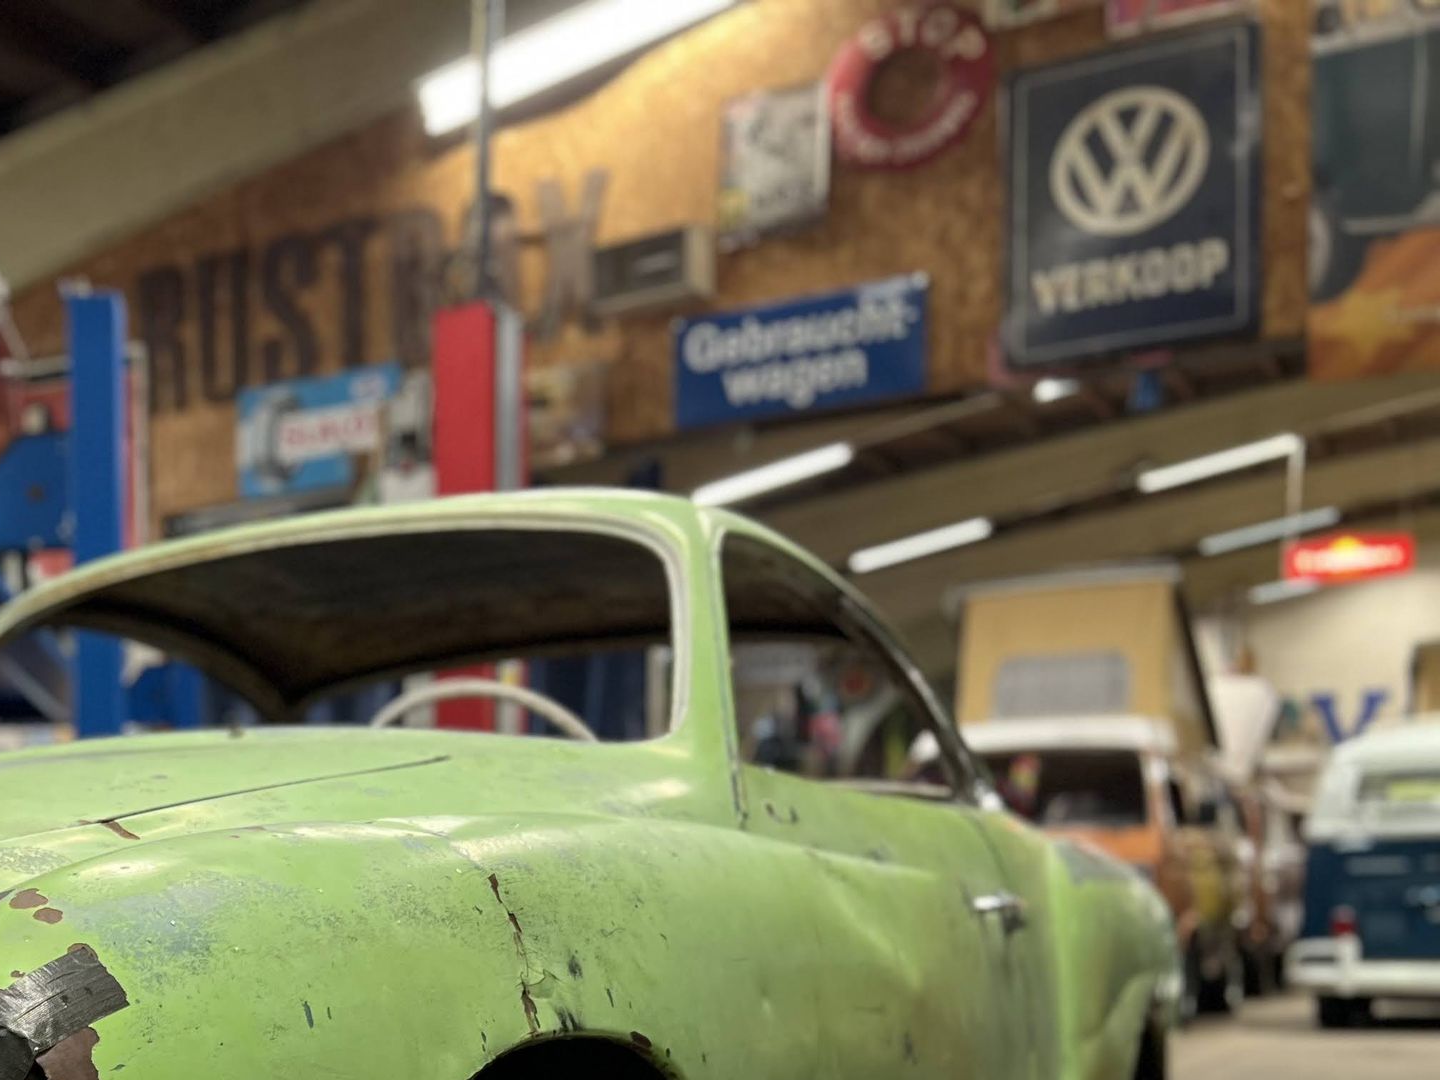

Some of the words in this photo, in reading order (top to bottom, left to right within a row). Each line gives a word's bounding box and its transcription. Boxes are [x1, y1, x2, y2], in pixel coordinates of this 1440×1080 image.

[1050, 86, 1211, 235] VW
[1032, 238, 1229, 315] VERKOOP
[722, 350, 867, 409] wagen
